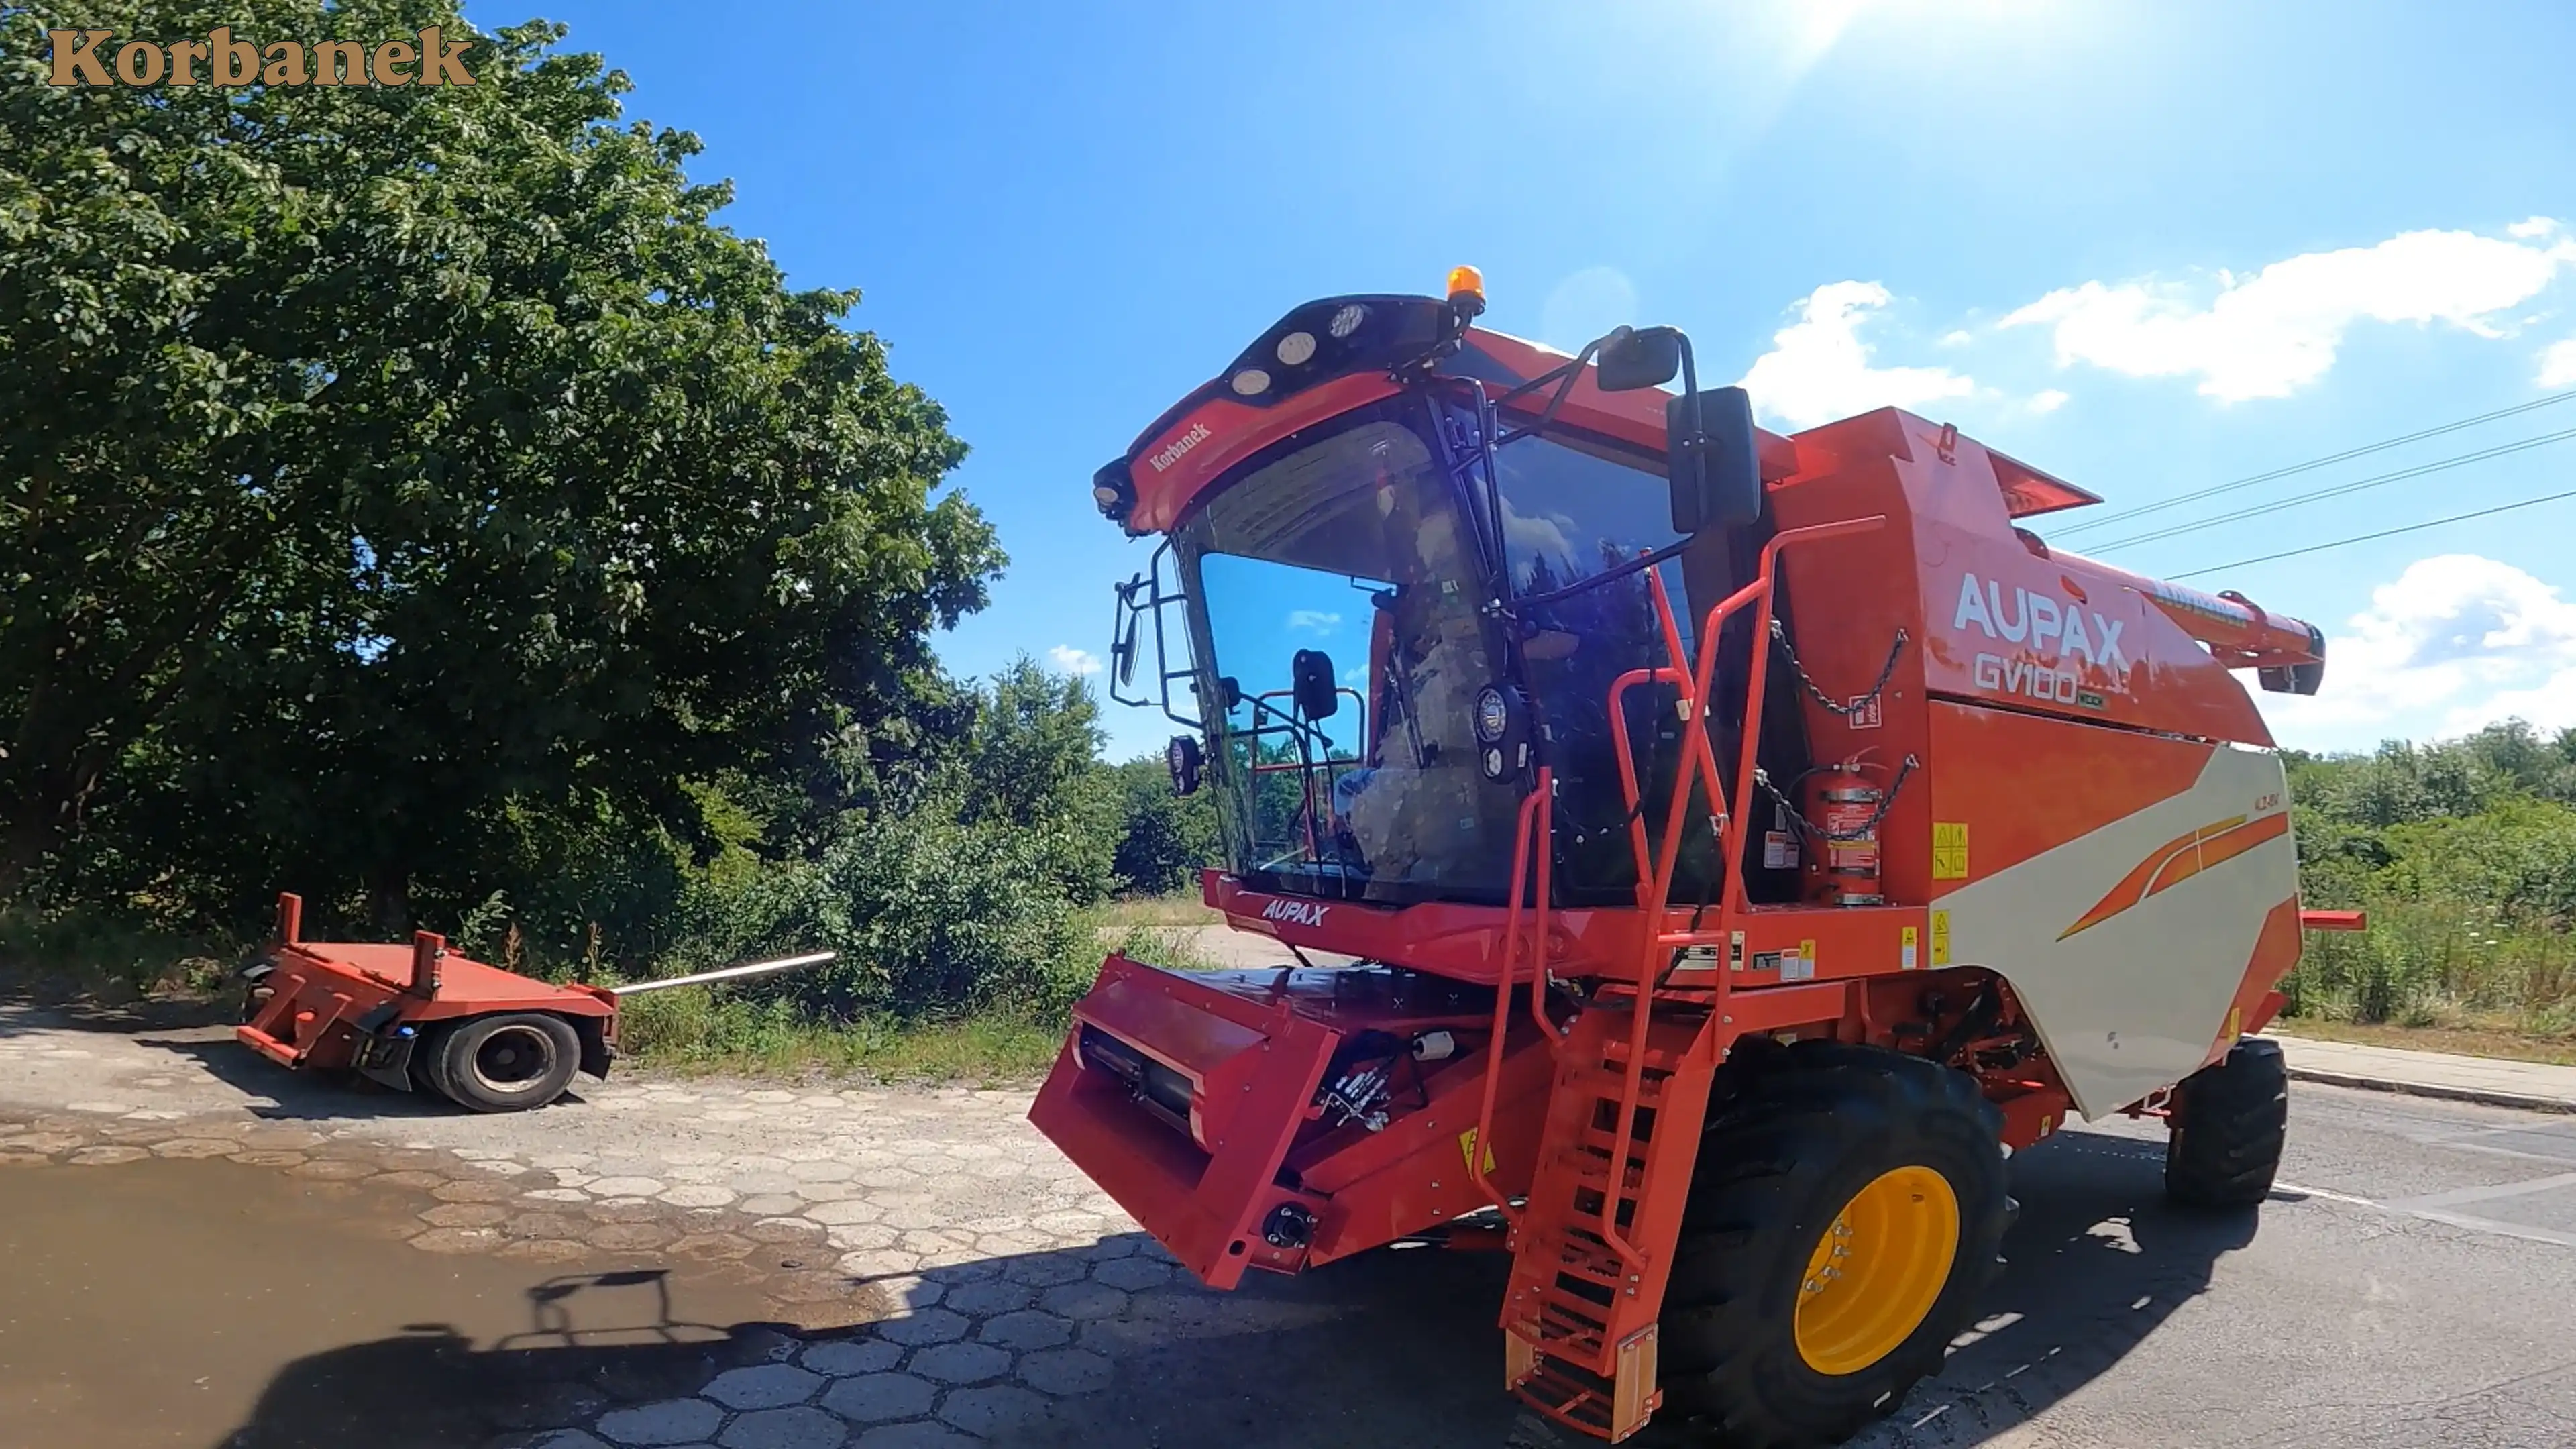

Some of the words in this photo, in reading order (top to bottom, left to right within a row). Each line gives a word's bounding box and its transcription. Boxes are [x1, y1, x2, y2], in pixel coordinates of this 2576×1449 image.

[1149, 422, 1212, 472] Korbanek
[1954, 572, 2130, 673] AUPAX
[1974, 652, 2078, 704] GV100
[1262, 899, 1330, 927] AUPAX
